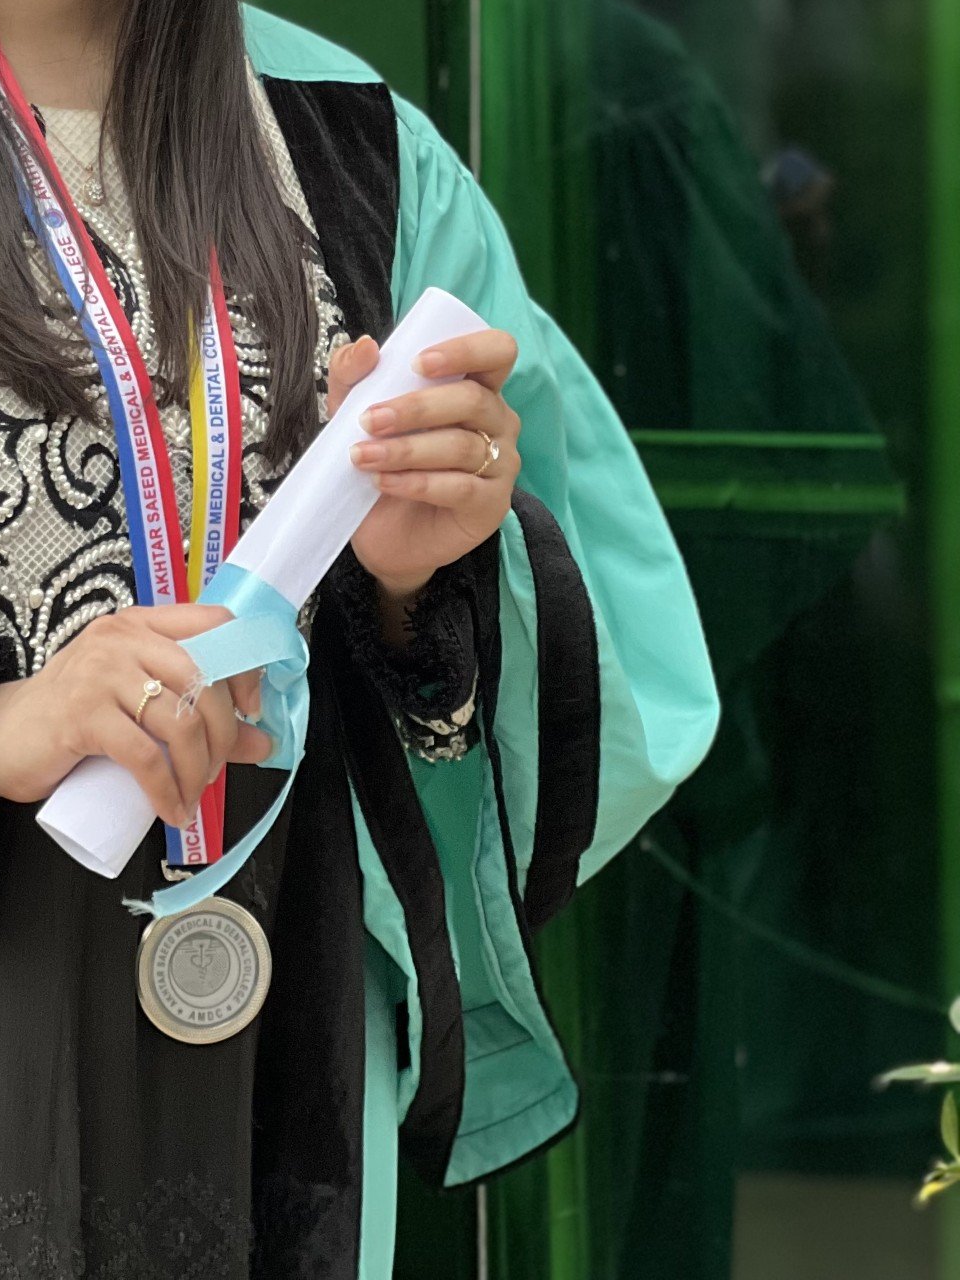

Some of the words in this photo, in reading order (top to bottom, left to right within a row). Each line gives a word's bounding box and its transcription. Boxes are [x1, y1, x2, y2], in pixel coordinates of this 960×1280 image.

[58, 235, 99, 305] COLLEGE
[94, 308, 127, 367] DENTAL
[120, 370, 132, 382] &
[207, 363, 224, 428] DENTAL
[126, 386, 151, 462] MEDICAL
[211, 433, 225, 444] &
[140, 465, 160, 522] SAEED
[210, 448, 225, 524] MEDICAL
[149, 526, 170, 596] AKHTAR
[174, 918, 214, 938] MEDICAL
[224, 924, 249, 956] DENTAL
[157, 936, 176, 968] SAEED
[156, 971, 178, 1007] AKHTAR
[232, 959, 252, 1004] COLLEGE
[188, 1007, 223, 1021] AMDC
